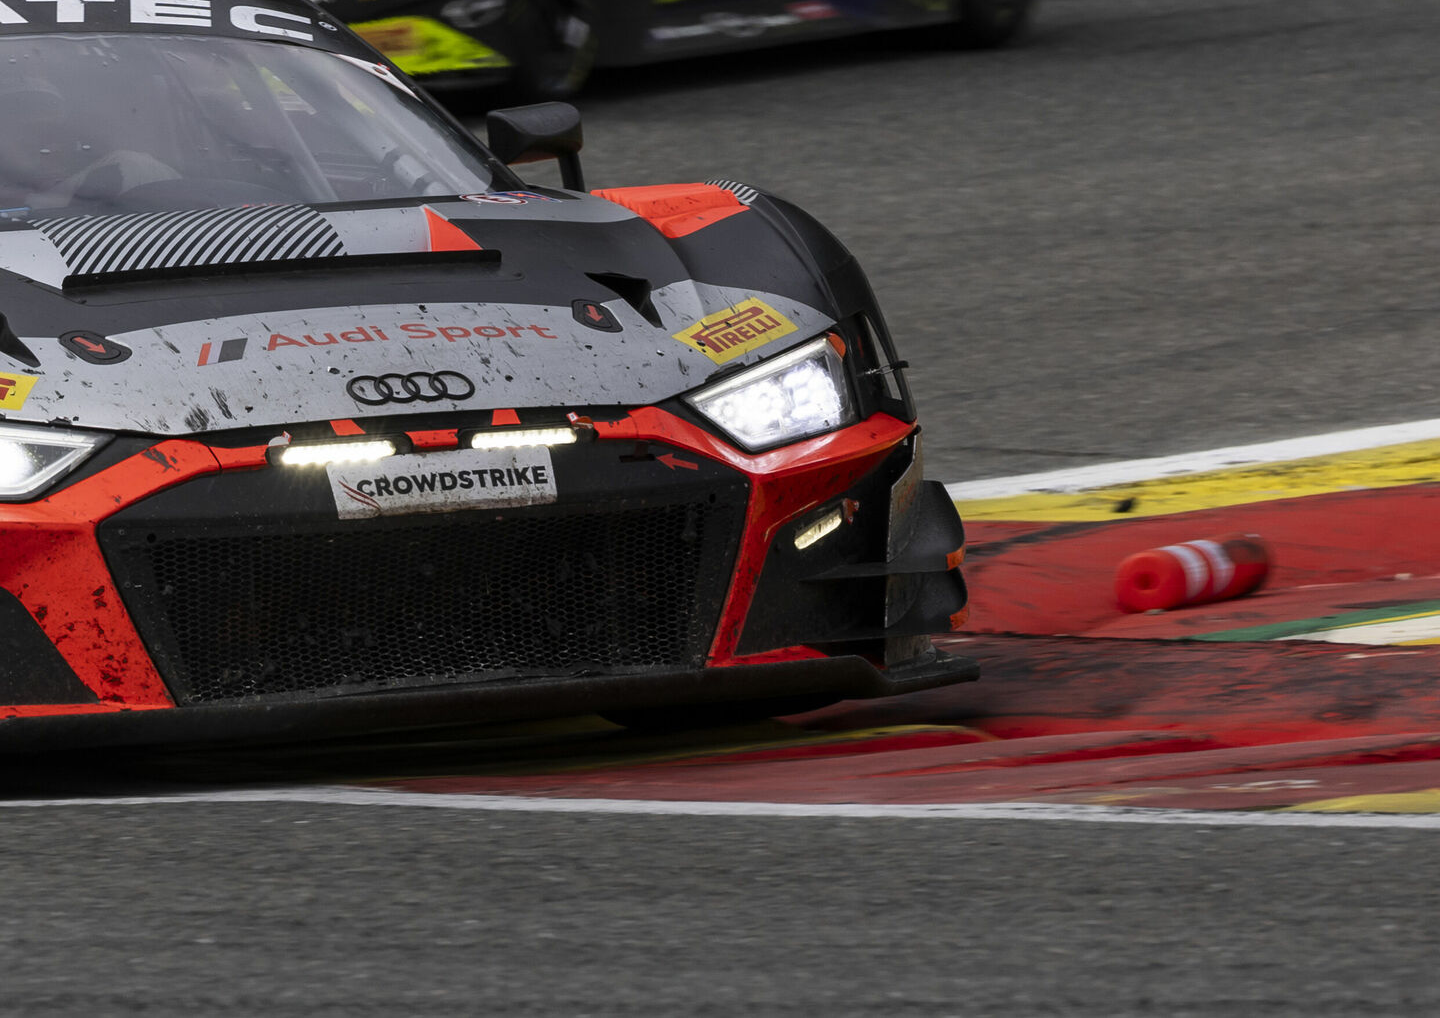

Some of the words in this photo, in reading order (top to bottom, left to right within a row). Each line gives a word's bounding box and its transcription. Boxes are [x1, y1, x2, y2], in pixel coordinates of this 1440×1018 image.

[267, 324, 389, 351] Audi
[399, 323, 558, 342] Sport
[690, 305, 782, 353] PIRELLI
[357, 465, 549, 498] CROWDSTRIKE
